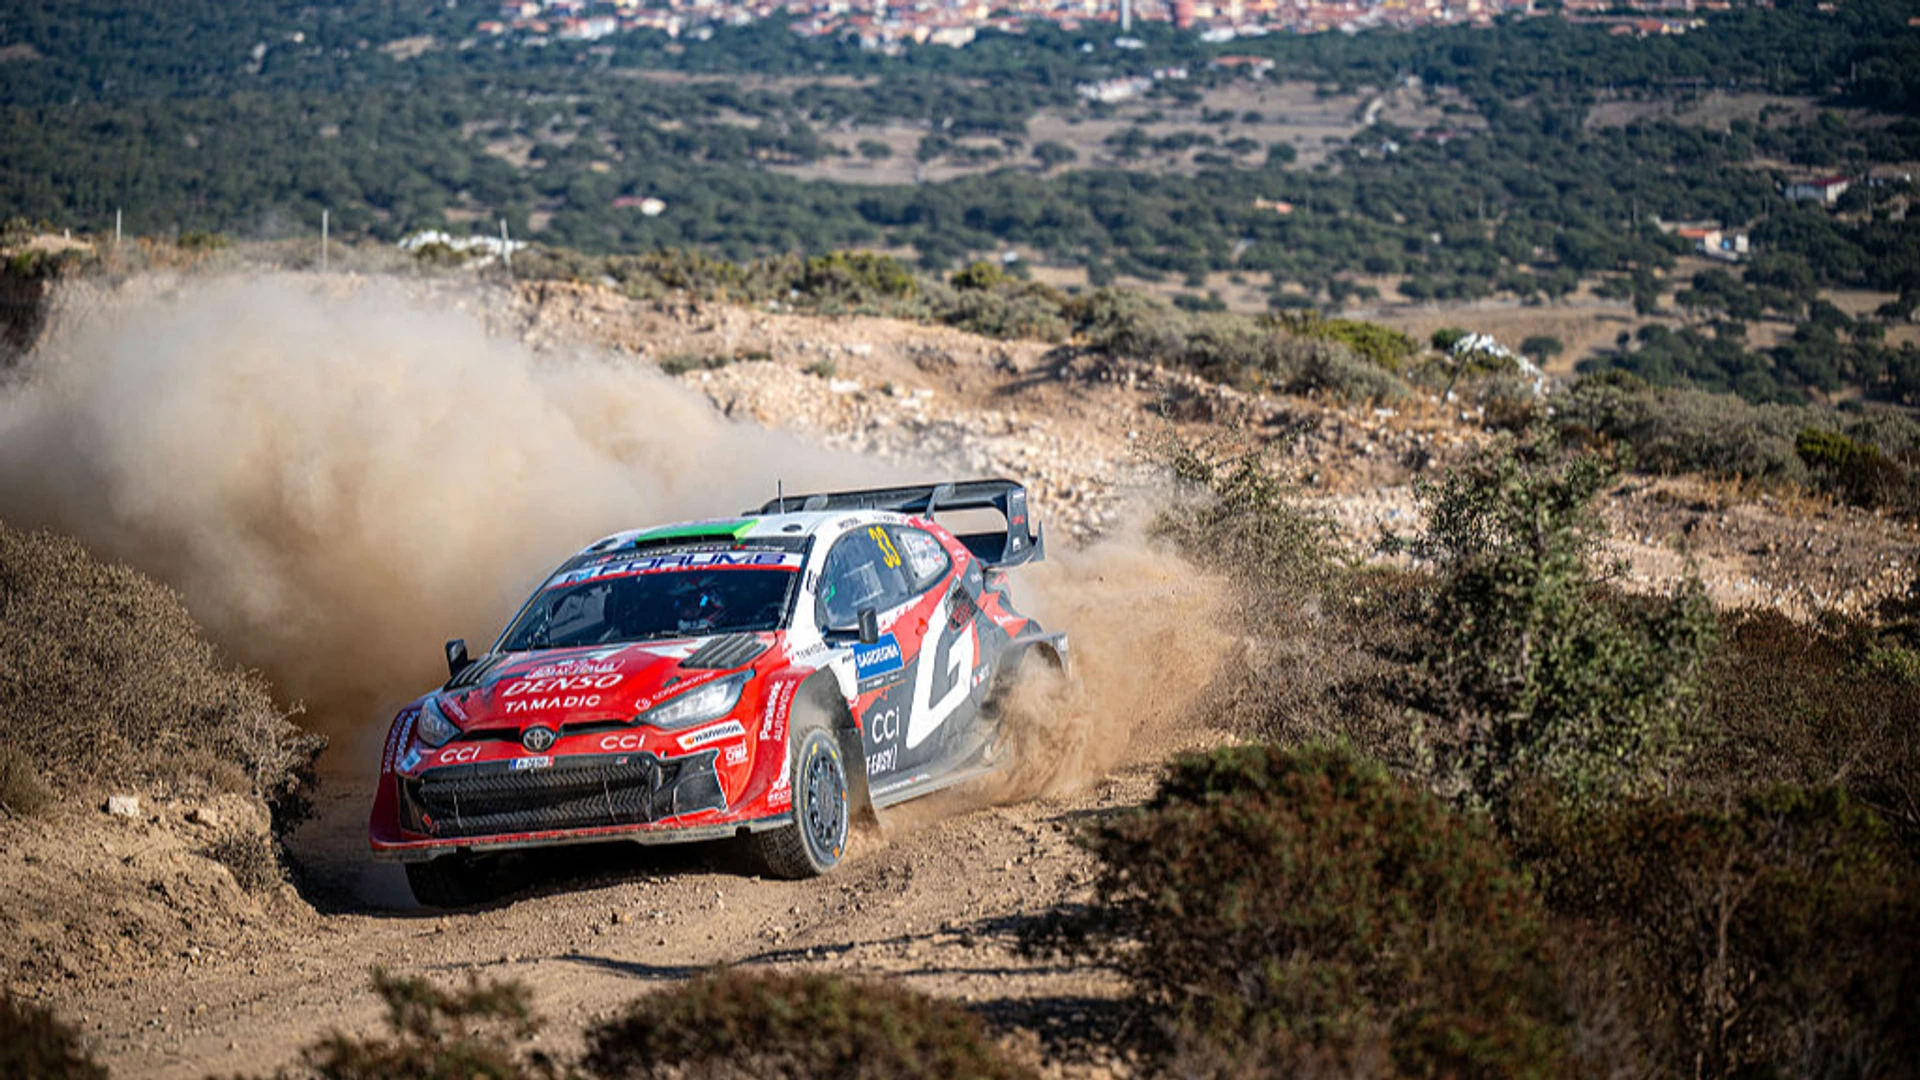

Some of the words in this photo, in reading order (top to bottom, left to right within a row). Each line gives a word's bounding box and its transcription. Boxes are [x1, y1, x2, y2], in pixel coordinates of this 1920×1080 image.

[868, 526, 901, 569] 33
[857, 644, 899, 667] SARDEGNA
[503, 674, 623, 697] DENSO
[505, 695, 601, 713] TAMADIC
[759, 681, 783, 741] Panasonic
